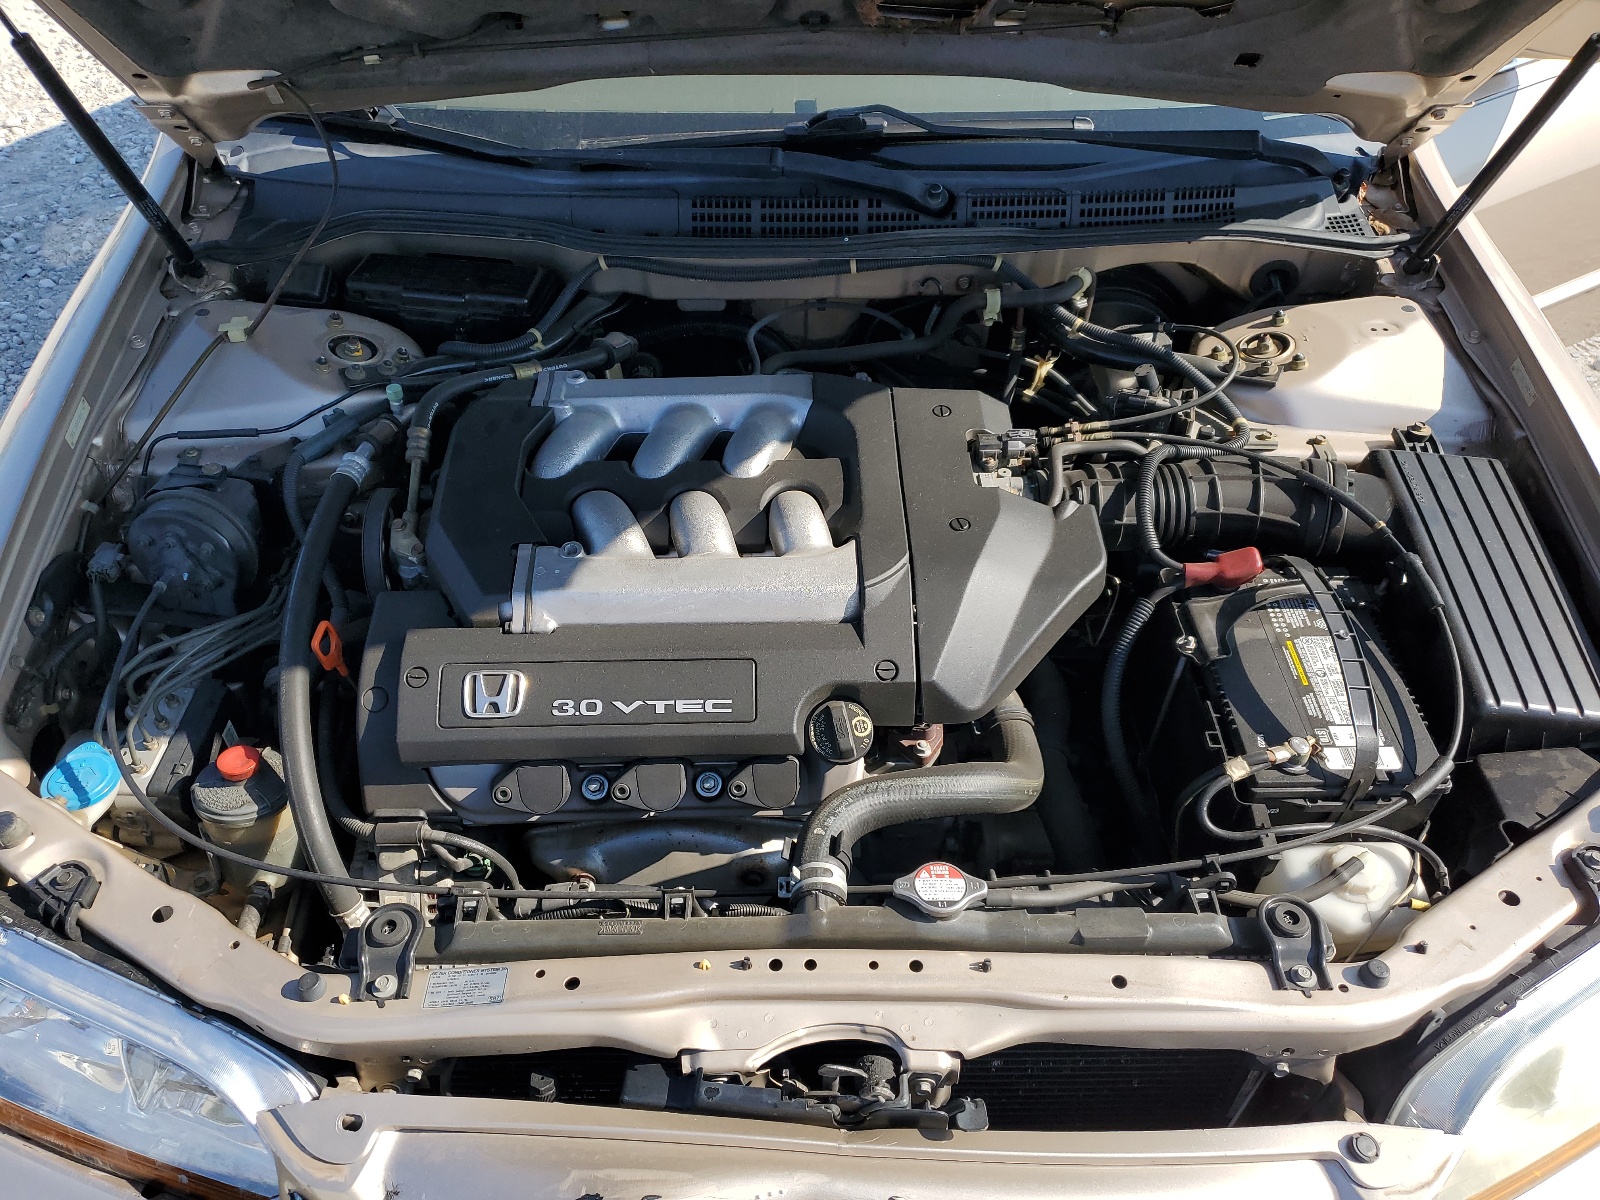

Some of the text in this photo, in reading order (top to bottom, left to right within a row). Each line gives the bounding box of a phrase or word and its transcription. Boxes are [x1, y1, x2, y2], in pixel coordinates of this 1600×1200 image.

[551, 699, 733, 716] 3.0 VTEC
[860, 738, 870, 749] OIL
